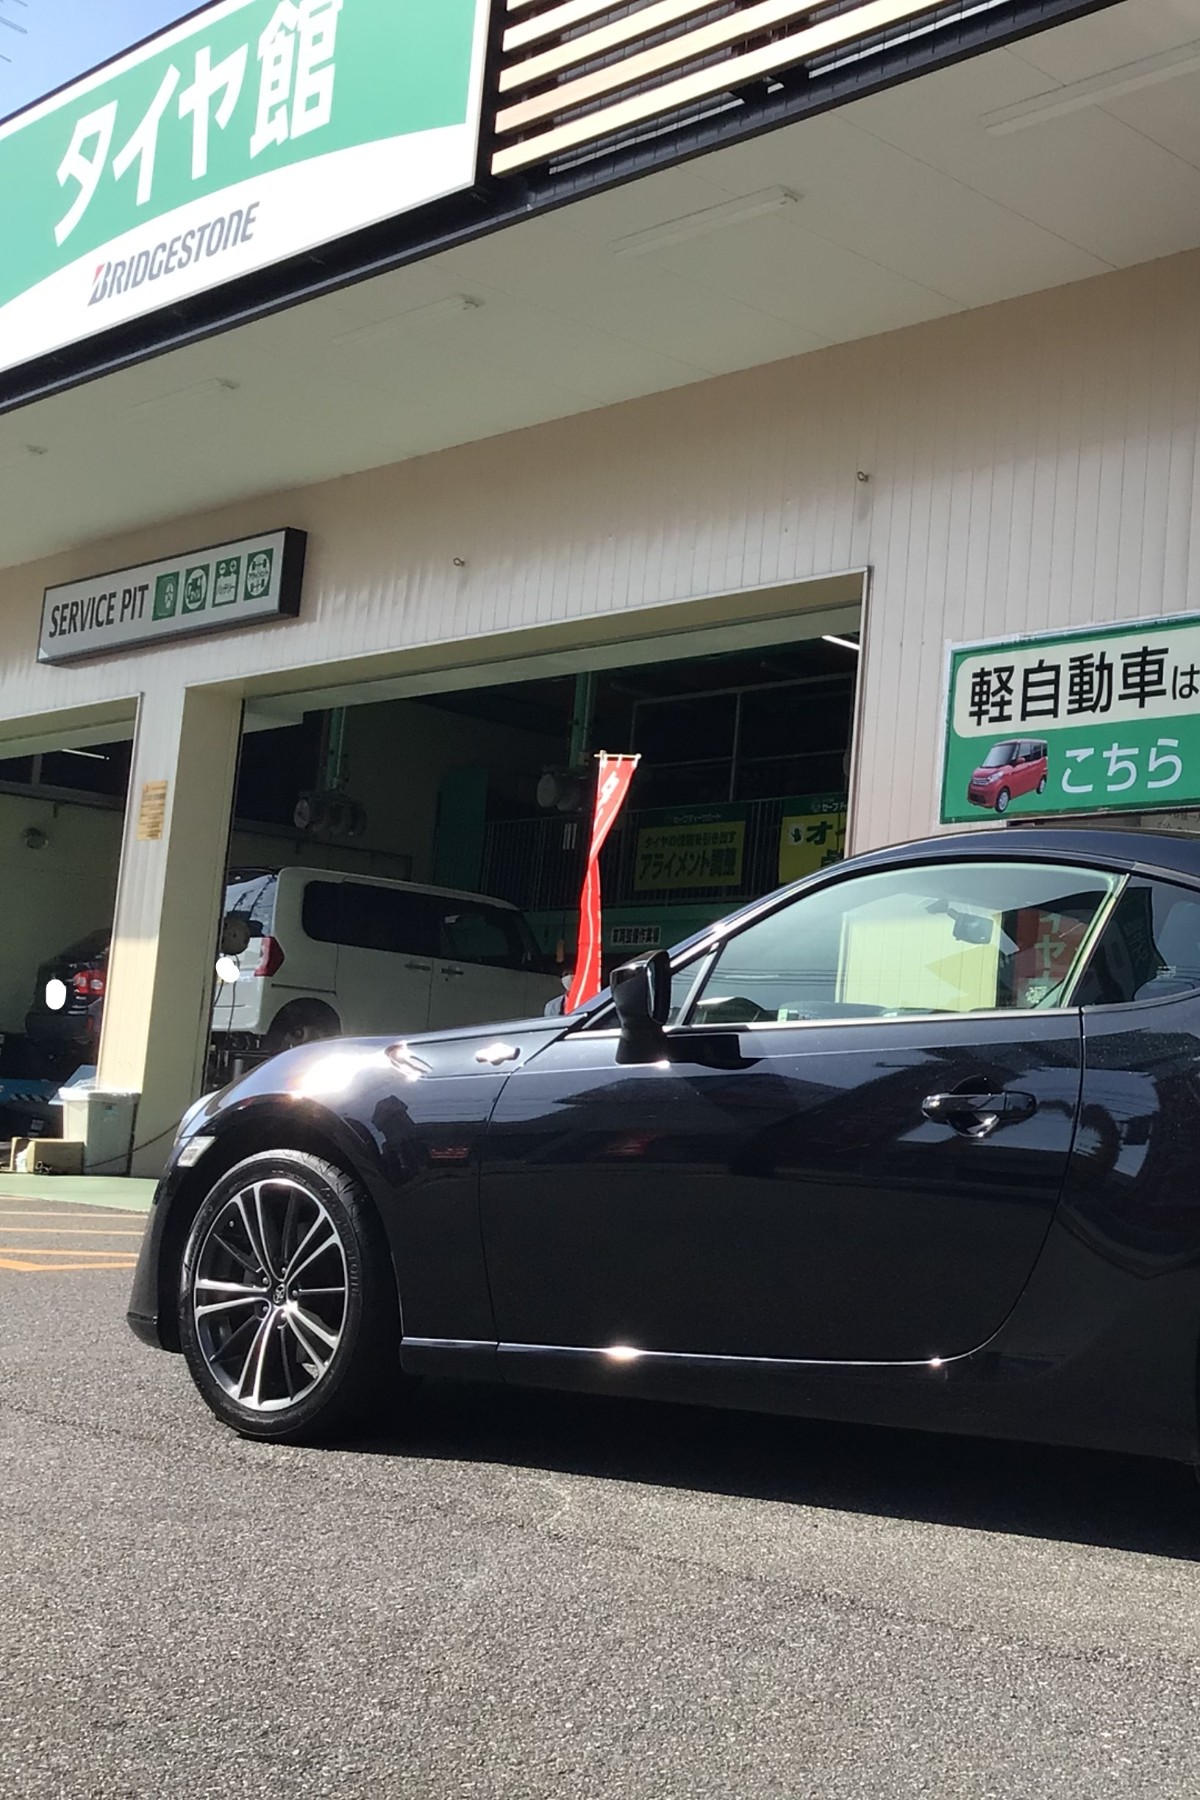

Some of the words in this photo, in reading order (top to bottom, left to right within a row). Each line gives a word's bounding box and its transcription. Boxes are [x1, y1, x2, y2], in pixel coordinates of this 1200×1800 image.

[54, 0, 345, 247] タイヤ館
[88, 201, 260, 306] BRIDGESTONE
[48, 587, 115, 638] SERVICE
[119, 583, 149, 622] PIT
[968, 645, 1200, 727] 軽自動車は
[1061, 738, 1183, 795] こちら
